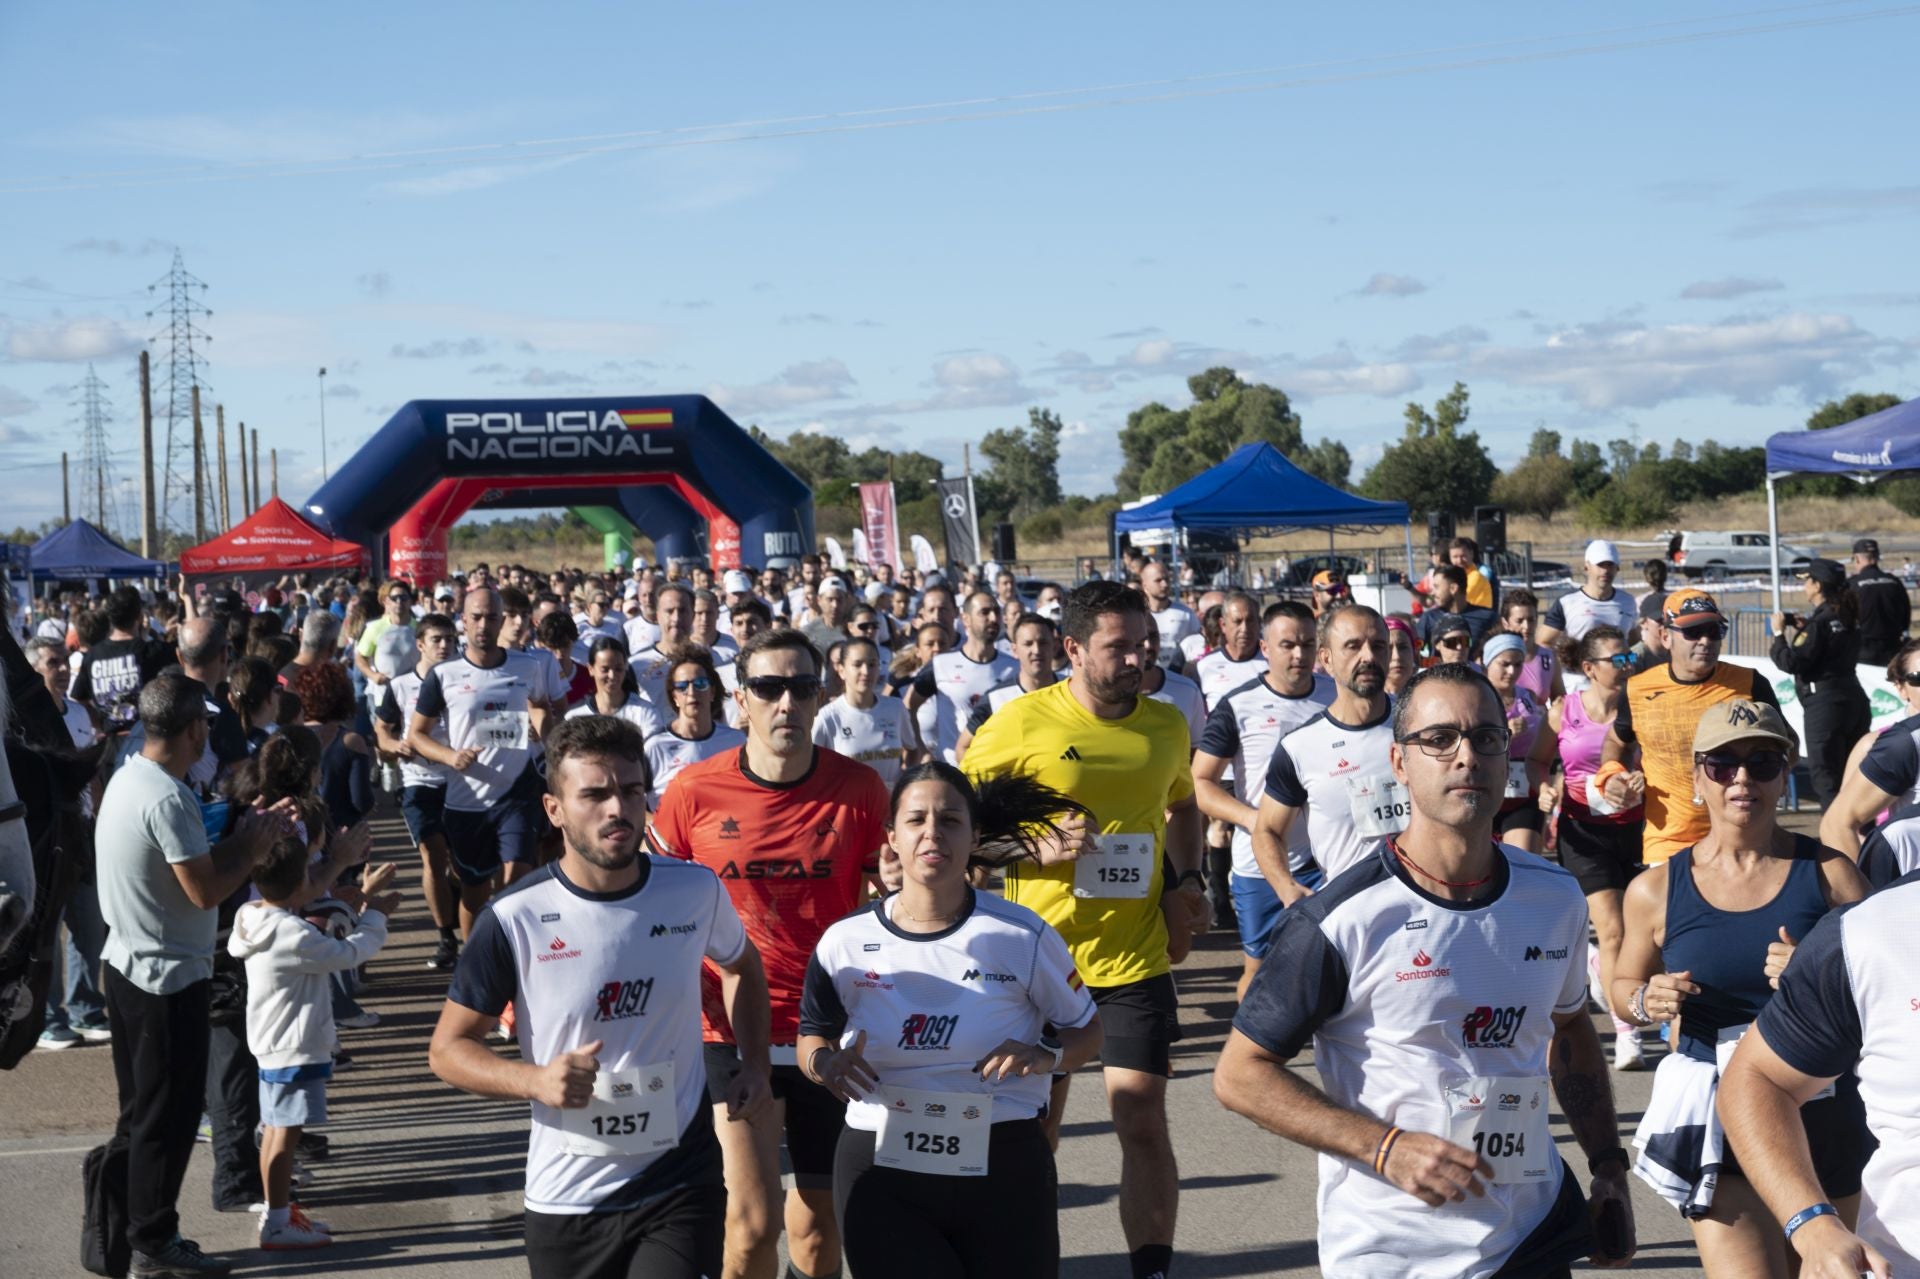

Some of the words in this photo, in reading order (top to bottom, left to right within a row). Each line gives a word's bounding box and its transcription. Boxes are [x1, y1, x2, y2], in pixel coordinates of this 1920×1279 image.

[446, 410, 628, 435] POLICIA
[447, 433, 674, 460] NACIONAL
[249, 536, 313, 546] Santander
[764, 532, 800, 556] RUTA
[91, 654, 138, 679] CHILL
[489, 730, 515, 740] 1514
[1374, 801, 1411, 821] 1303
[719, 860, 833, 880] ASFAS
[1097, 867, 1140, 883] 1525
[670, 921, 697, 936] mupol
[537, 949, 582, 963] Santander
[1546, 946, 1568, 962] mupol
[1395, 967, 1451, 982] Santander
[591, 1111, 650, 1135] 1257
[904, 1131, 960, 1156] 1258
[1472, 1131, 1525, 1157] 1054
